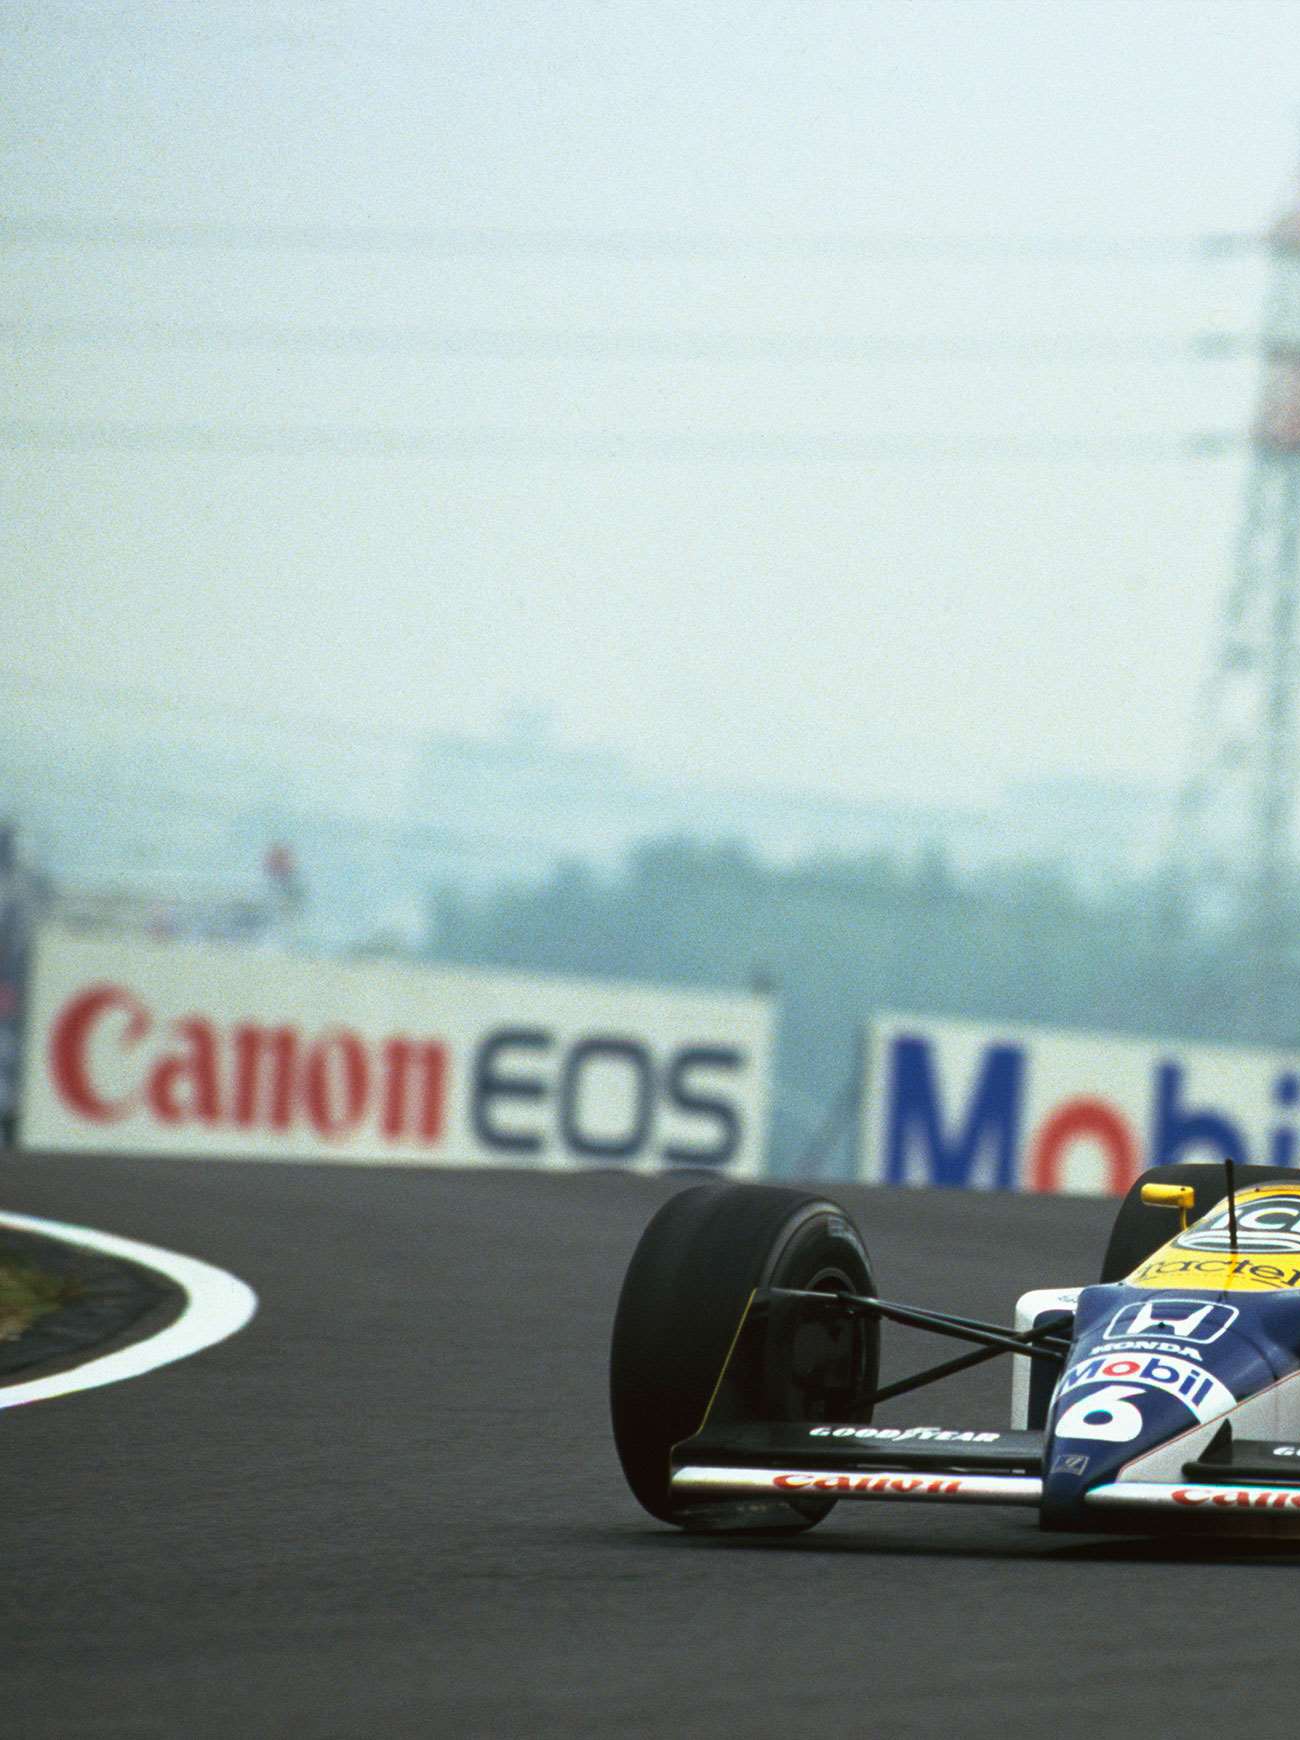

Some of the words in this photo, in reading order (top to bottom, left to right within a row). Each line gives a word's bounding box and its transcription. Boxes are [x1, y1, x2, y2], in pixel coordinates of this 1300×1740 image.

[48, 980, 450, 1147] Canon
[469, 1027, 748, 1168] EOS
[1087, 1340, 1204, 1362] HONDA
[1060, 1357, 1214, 1407] Mobil
[1054, 1385, 1147, 1443] 6
[809, 1426, 1001, 1442] GOODYEAR
[773, 1473, 961, 1494] Canon
